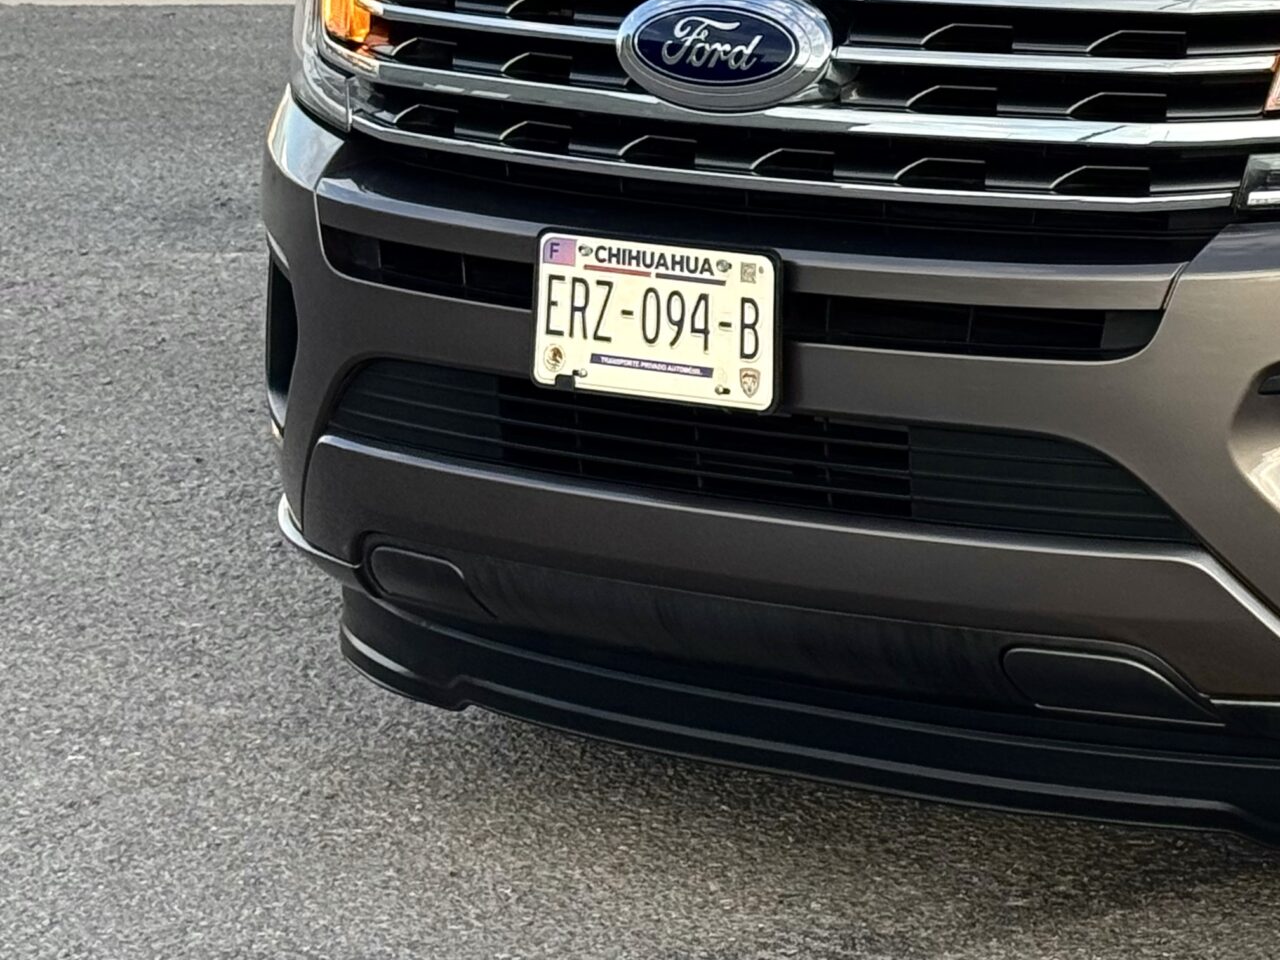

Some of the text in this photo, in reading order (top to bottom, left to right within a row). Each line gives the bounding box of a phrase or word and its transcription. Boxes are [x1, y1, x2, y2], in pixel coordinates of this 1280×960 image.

[661, 16, 763, 71] Ford
[549, 242, 560, 259] F
[594, 245, 714, 276] CHIHUAHUA
[545, 274, 760, 360] ERZ-094-B
